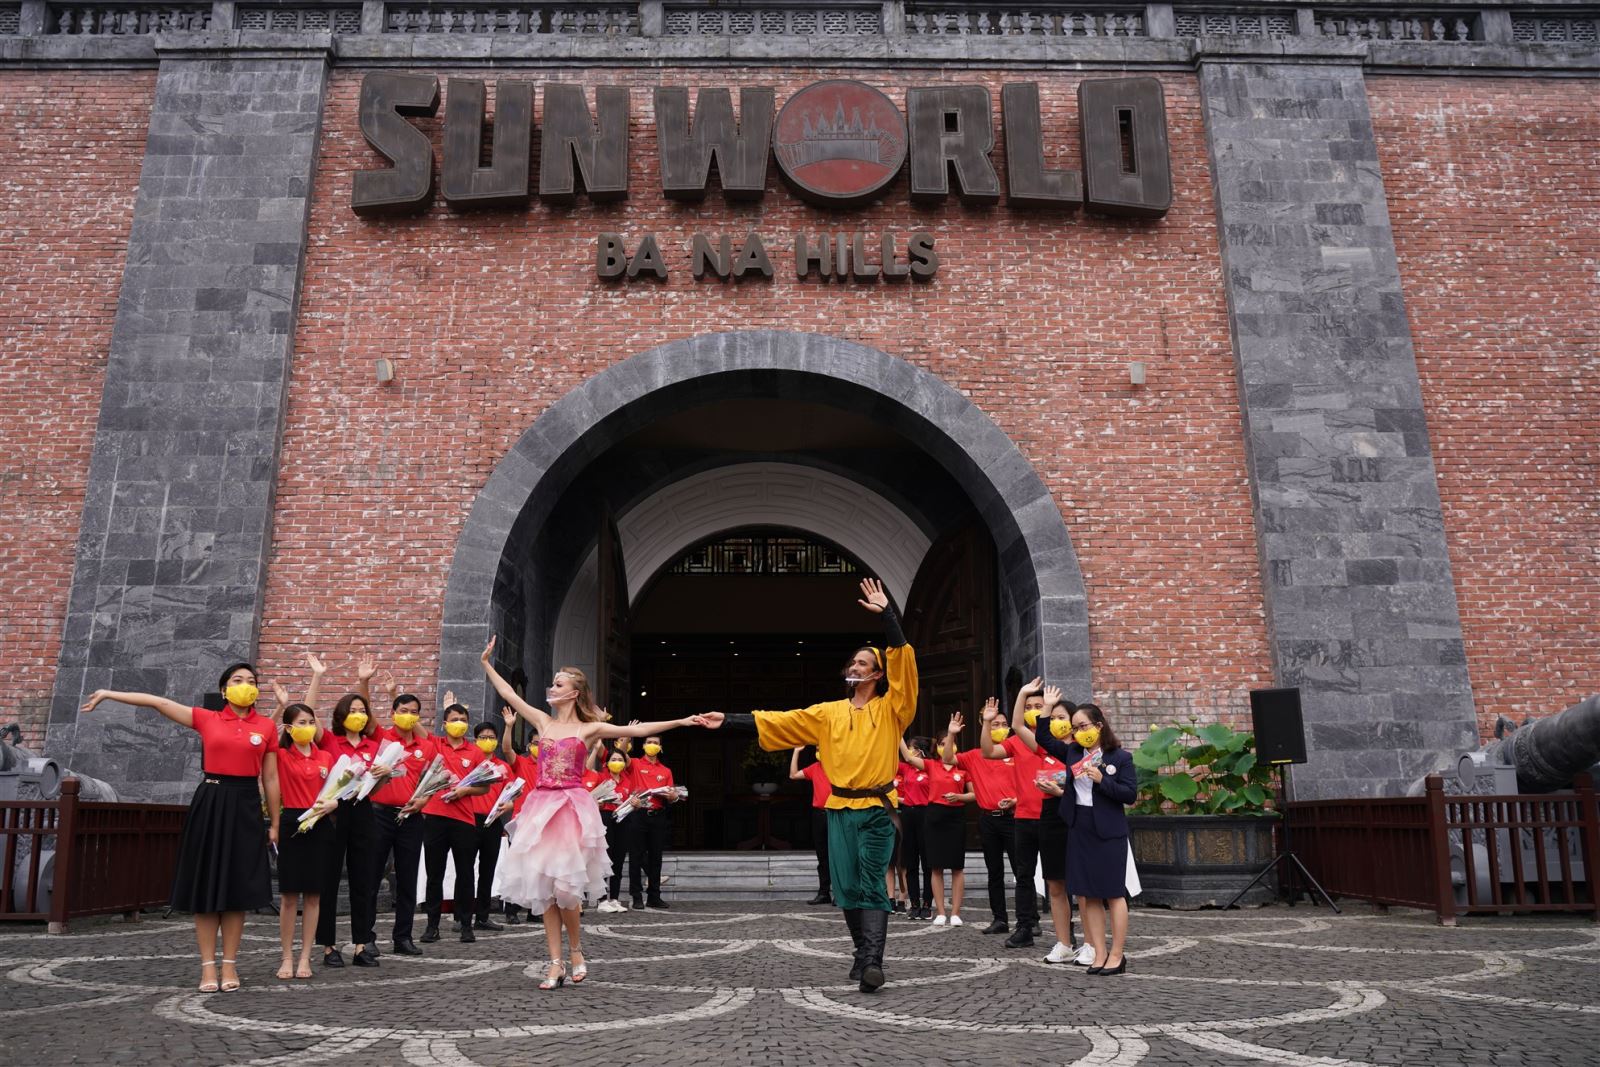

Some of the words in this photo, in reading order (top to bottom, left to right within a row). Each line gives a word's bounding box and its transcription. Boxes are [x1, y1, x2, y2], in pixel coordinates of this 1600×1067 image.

[352, 70, 630, 213] SUN
[597, 231, 668, 281] BA
[692, 231, 774, 281] NA
[795, 231, 939, 281] HILLS
